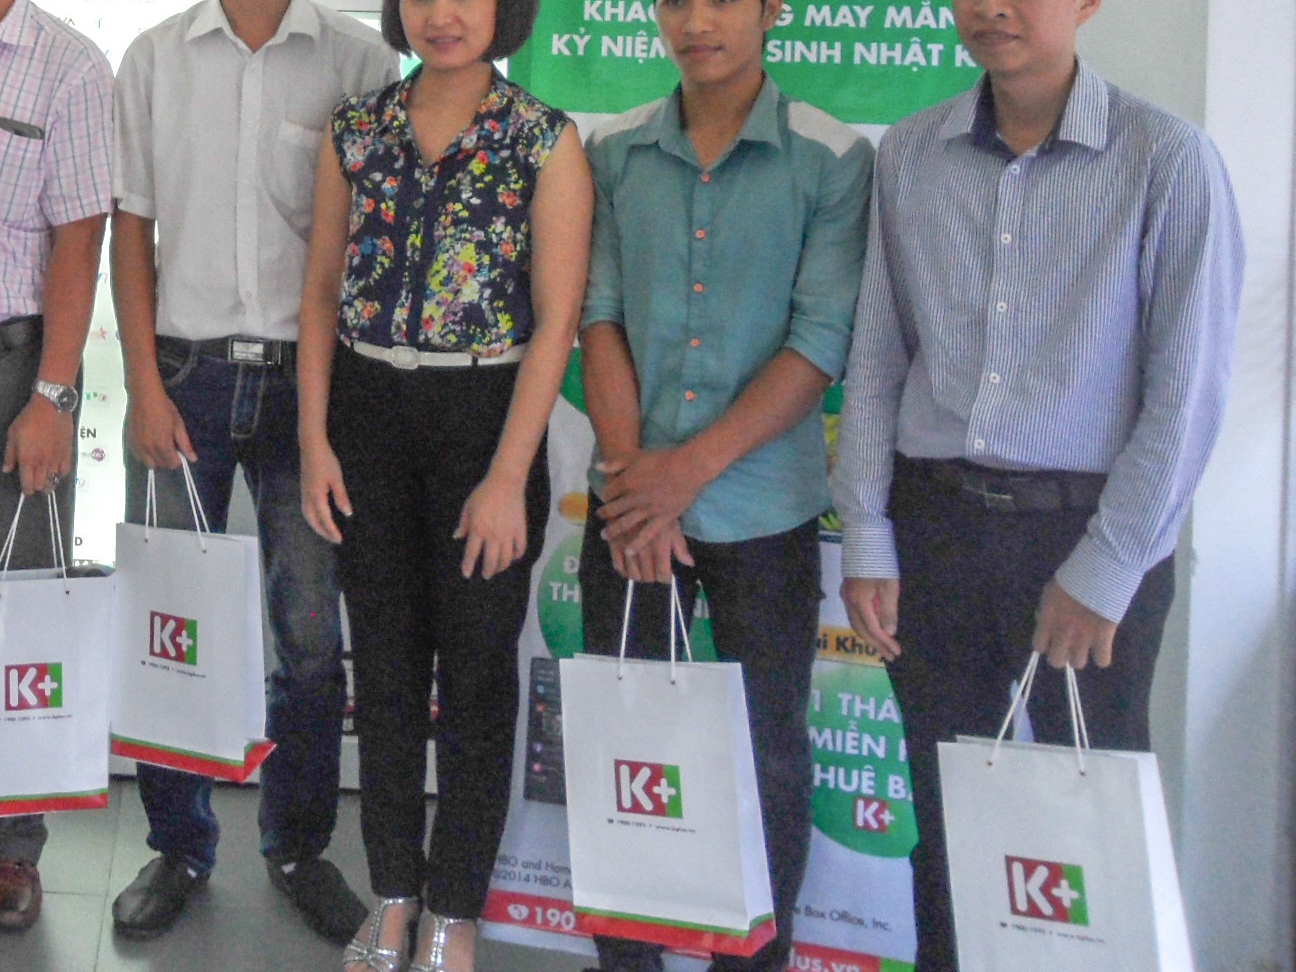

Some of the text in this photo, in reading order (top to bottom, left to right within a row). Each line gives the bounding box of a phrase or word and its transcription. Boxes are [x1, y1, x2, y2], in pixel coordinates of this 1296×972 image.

[804, 4, 874, 29] MAY
[766, 39, 842, 66] SINH
[853, 39, 944, 73] NHẬT
[151, 615, 193, 657] K+
[9, 666, 58, 707] K+
[619, 763, 676, 812] K+
[813, 762, 876, 796] HUÊ
[855, 799, 896, 830] K+
[522, 860, 543, 871] and
[534, 874, 561, 887] HBO
[1012, 861, 1081, 918] K+
[805, 905, 826, 920] Box
